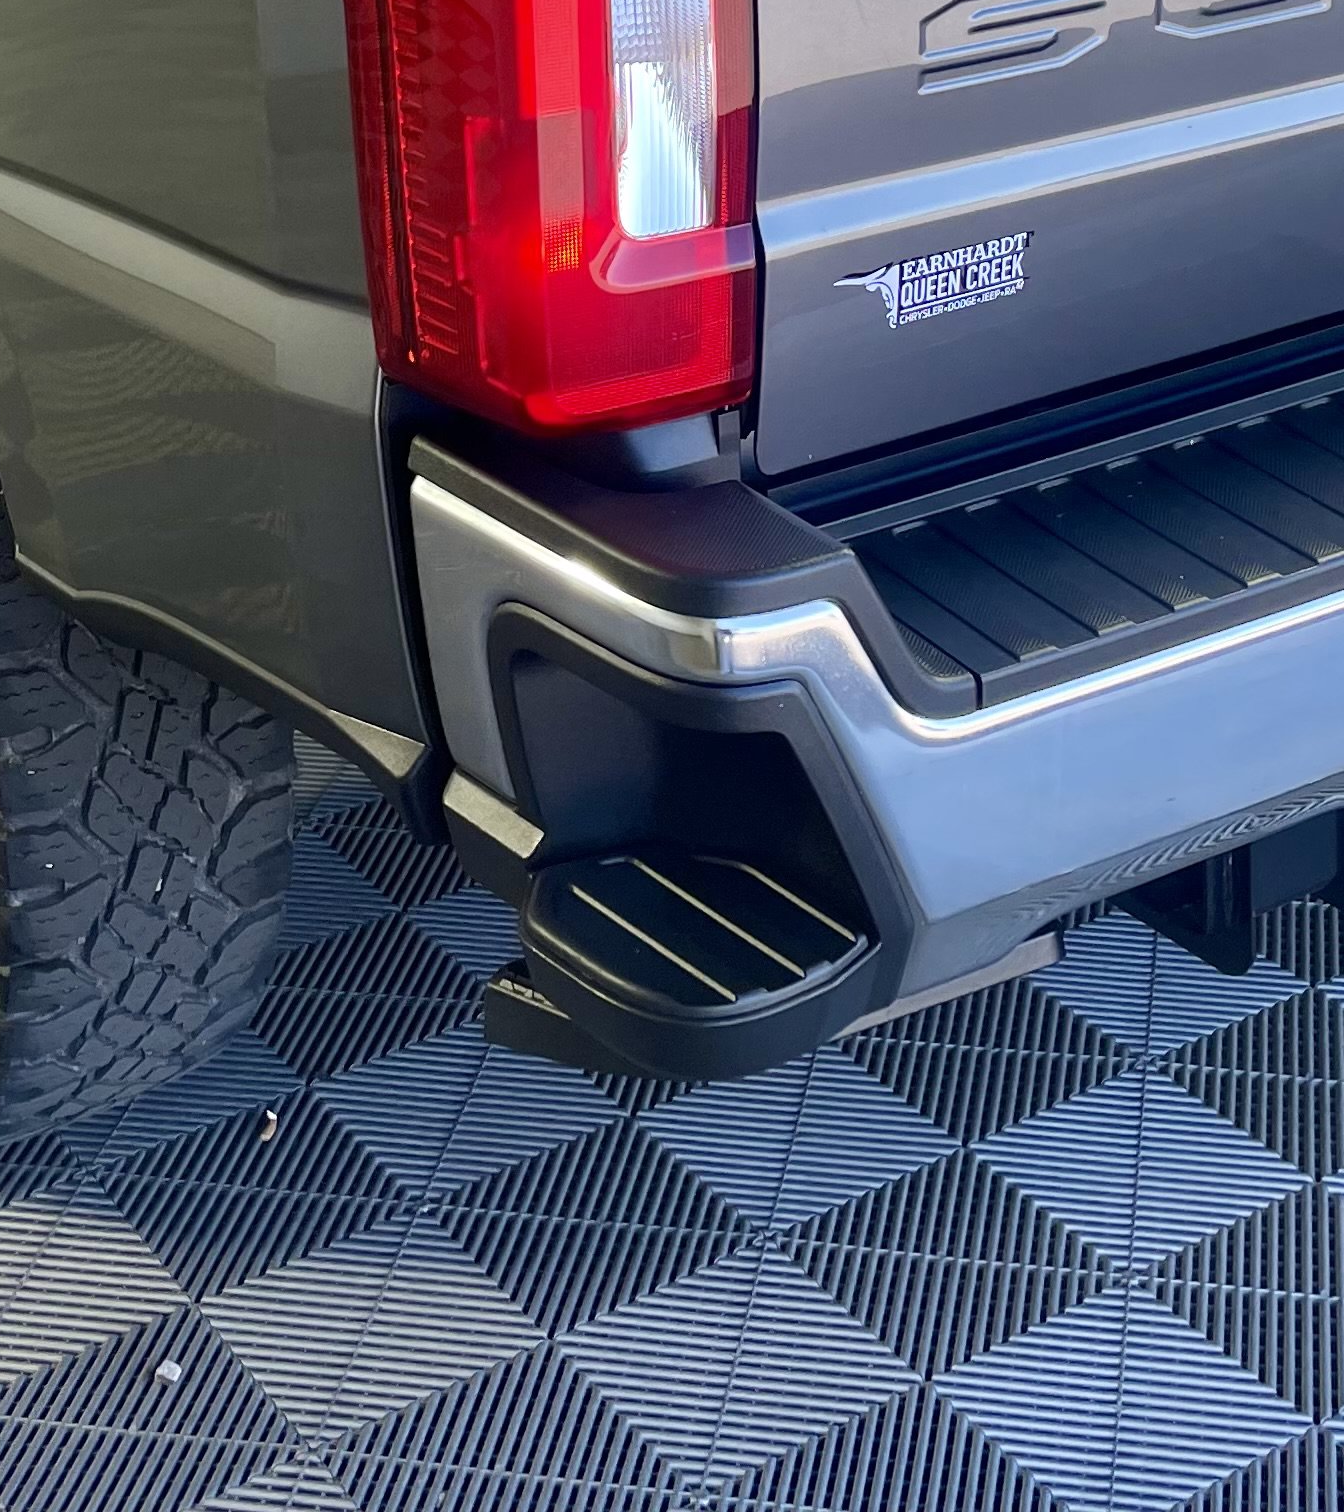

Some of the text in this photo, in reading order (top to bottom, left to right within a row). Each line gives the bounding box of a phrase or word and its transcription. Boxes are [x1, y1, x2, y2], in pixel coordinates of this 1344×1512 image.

[900, 252, 1025, 308] QUEEN CREEK
[901, 231, 1029, 280] EARNHARDT
